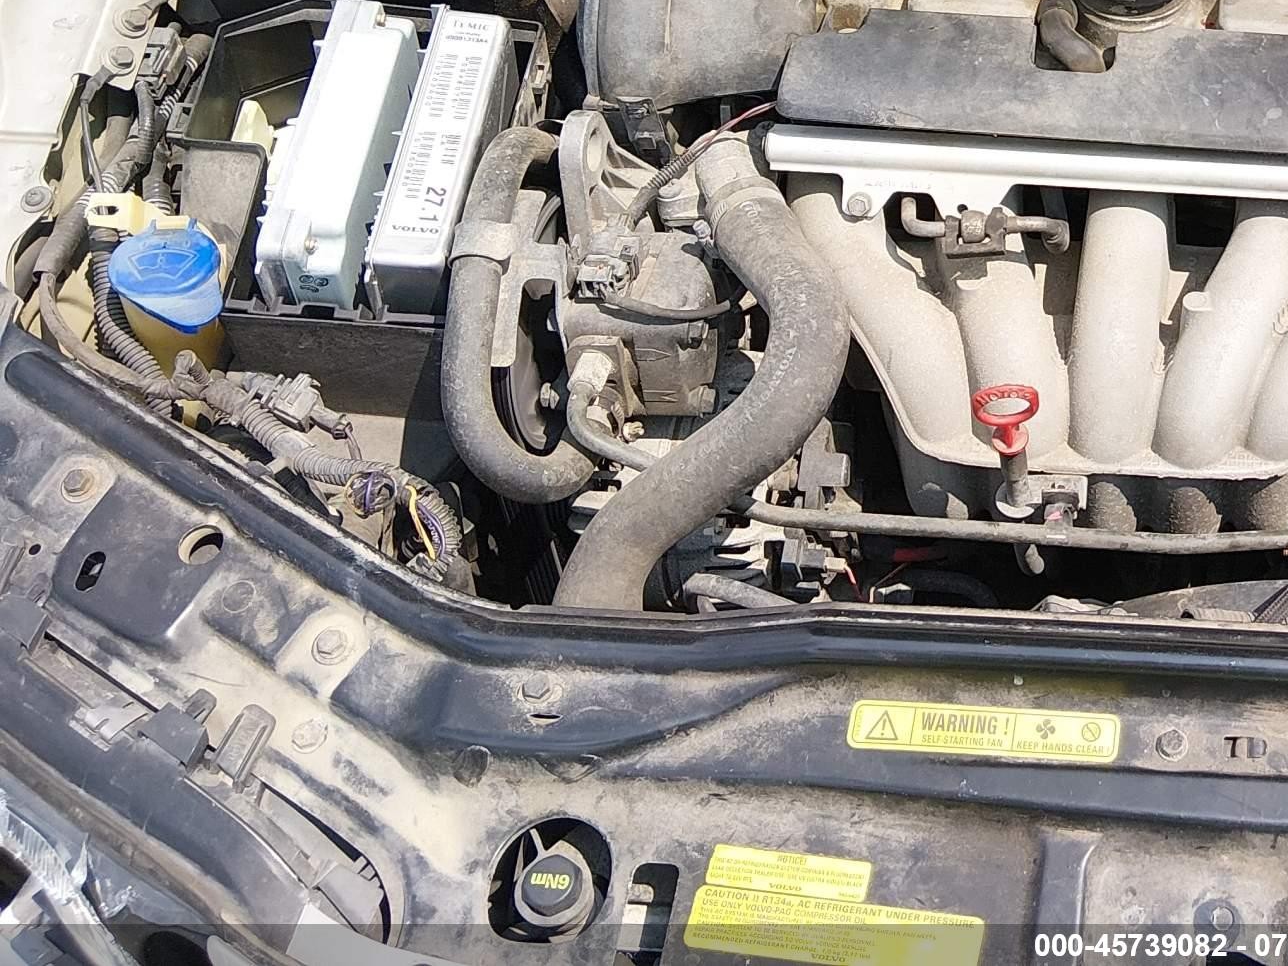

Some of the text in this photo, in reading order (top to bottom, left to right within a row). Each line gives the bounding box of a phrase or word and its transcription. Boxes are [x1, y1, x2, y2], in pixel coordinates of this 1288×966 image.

[419, 186, 446, 223] 27.1
[392, 224, 439, 234] VOLVO
[921, 711, 997, 735] WARNING
[1016, 740, 1040, 750] KEEP
[1042, 742, 1073, 752] HANDS
[1076, 744, 1104, 754] CLEAR
[531, 872, 570, 890] 6Nm
[702, 899, 718, 907] USE
[704, 888, 749, 900] CAUTION
[798, 899, 811, 909] AC
[815, 901, 882, 918] REFRIGERANT
[886, 910, 920, 922] UNDER
[923, 914, 975, 929] PRESSURE
